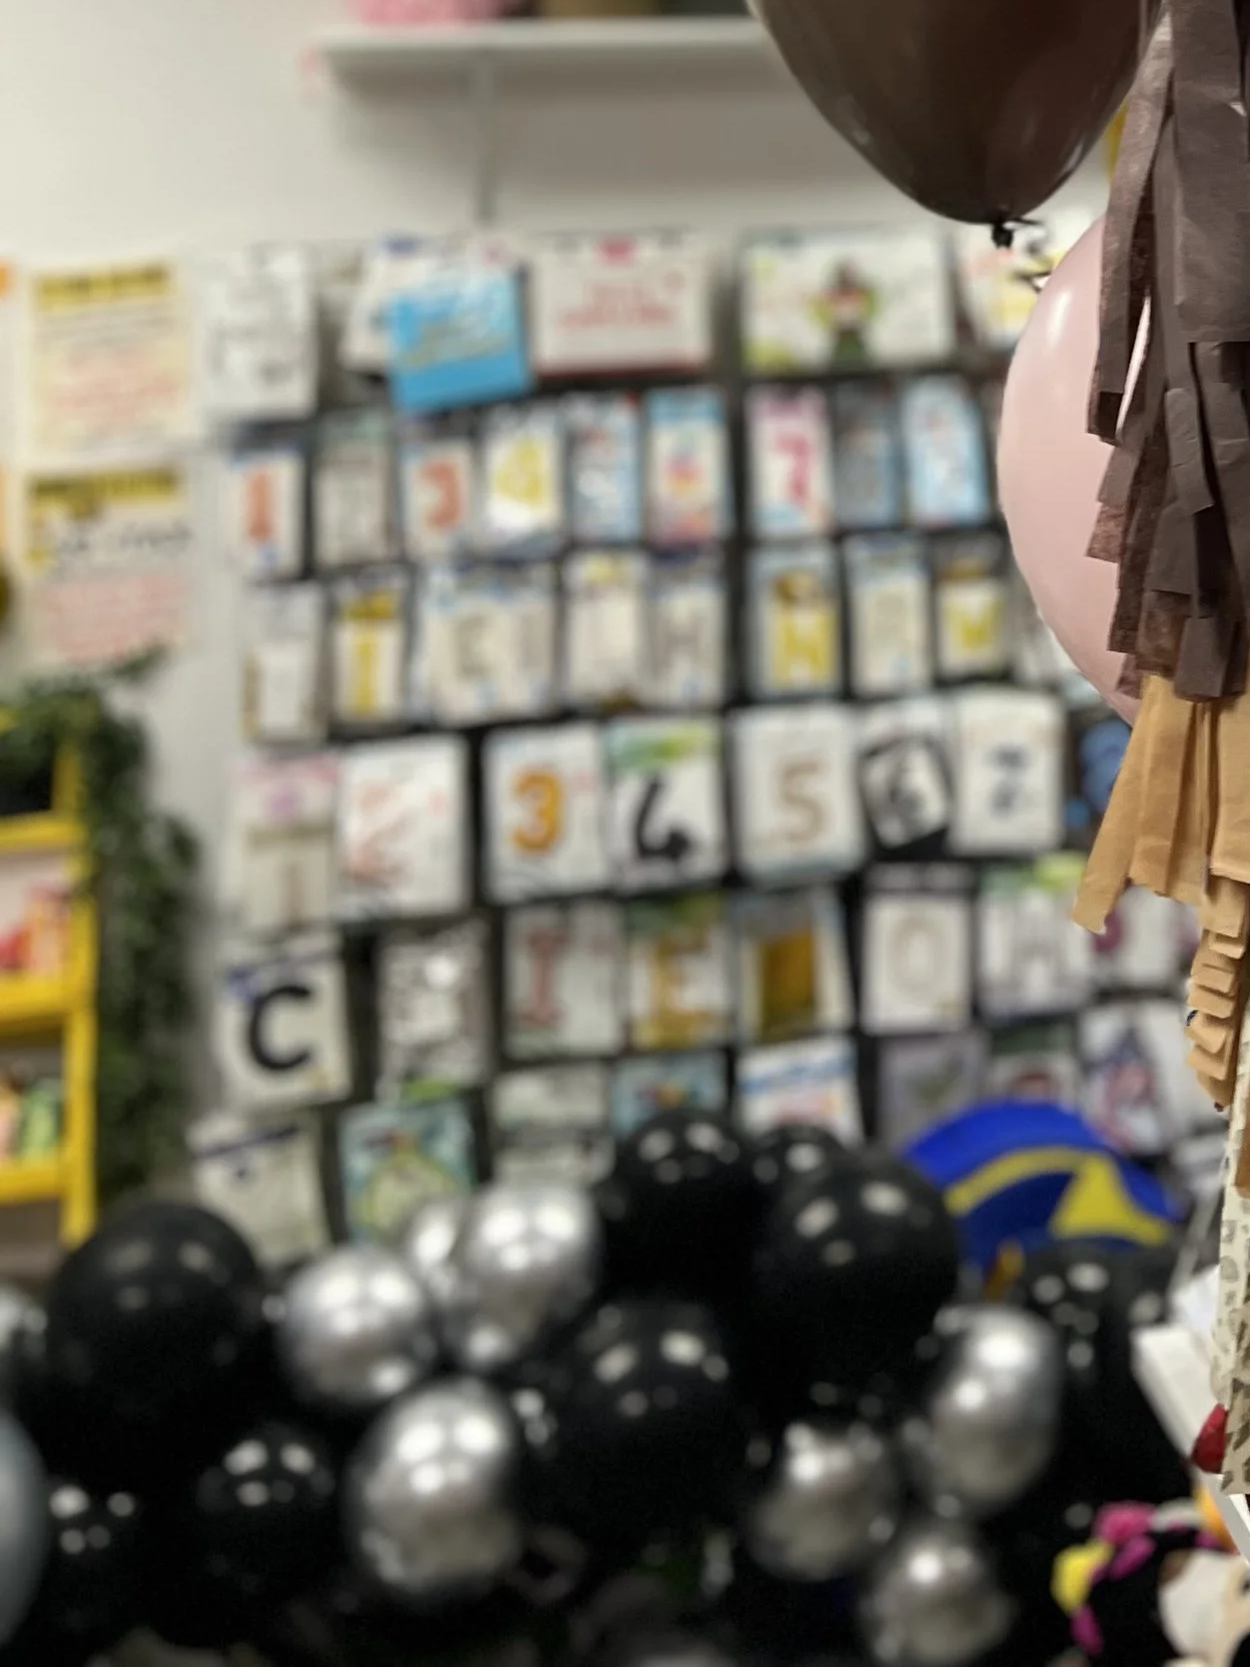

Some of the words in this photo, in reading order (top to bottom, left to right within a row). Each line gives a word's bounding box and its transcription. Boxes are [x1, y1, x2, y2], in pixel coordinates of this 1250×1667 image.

[508, 768, 566, 857] 3
[775, 755, 833, 843] 5
[247, 984, 312, 1071] C
